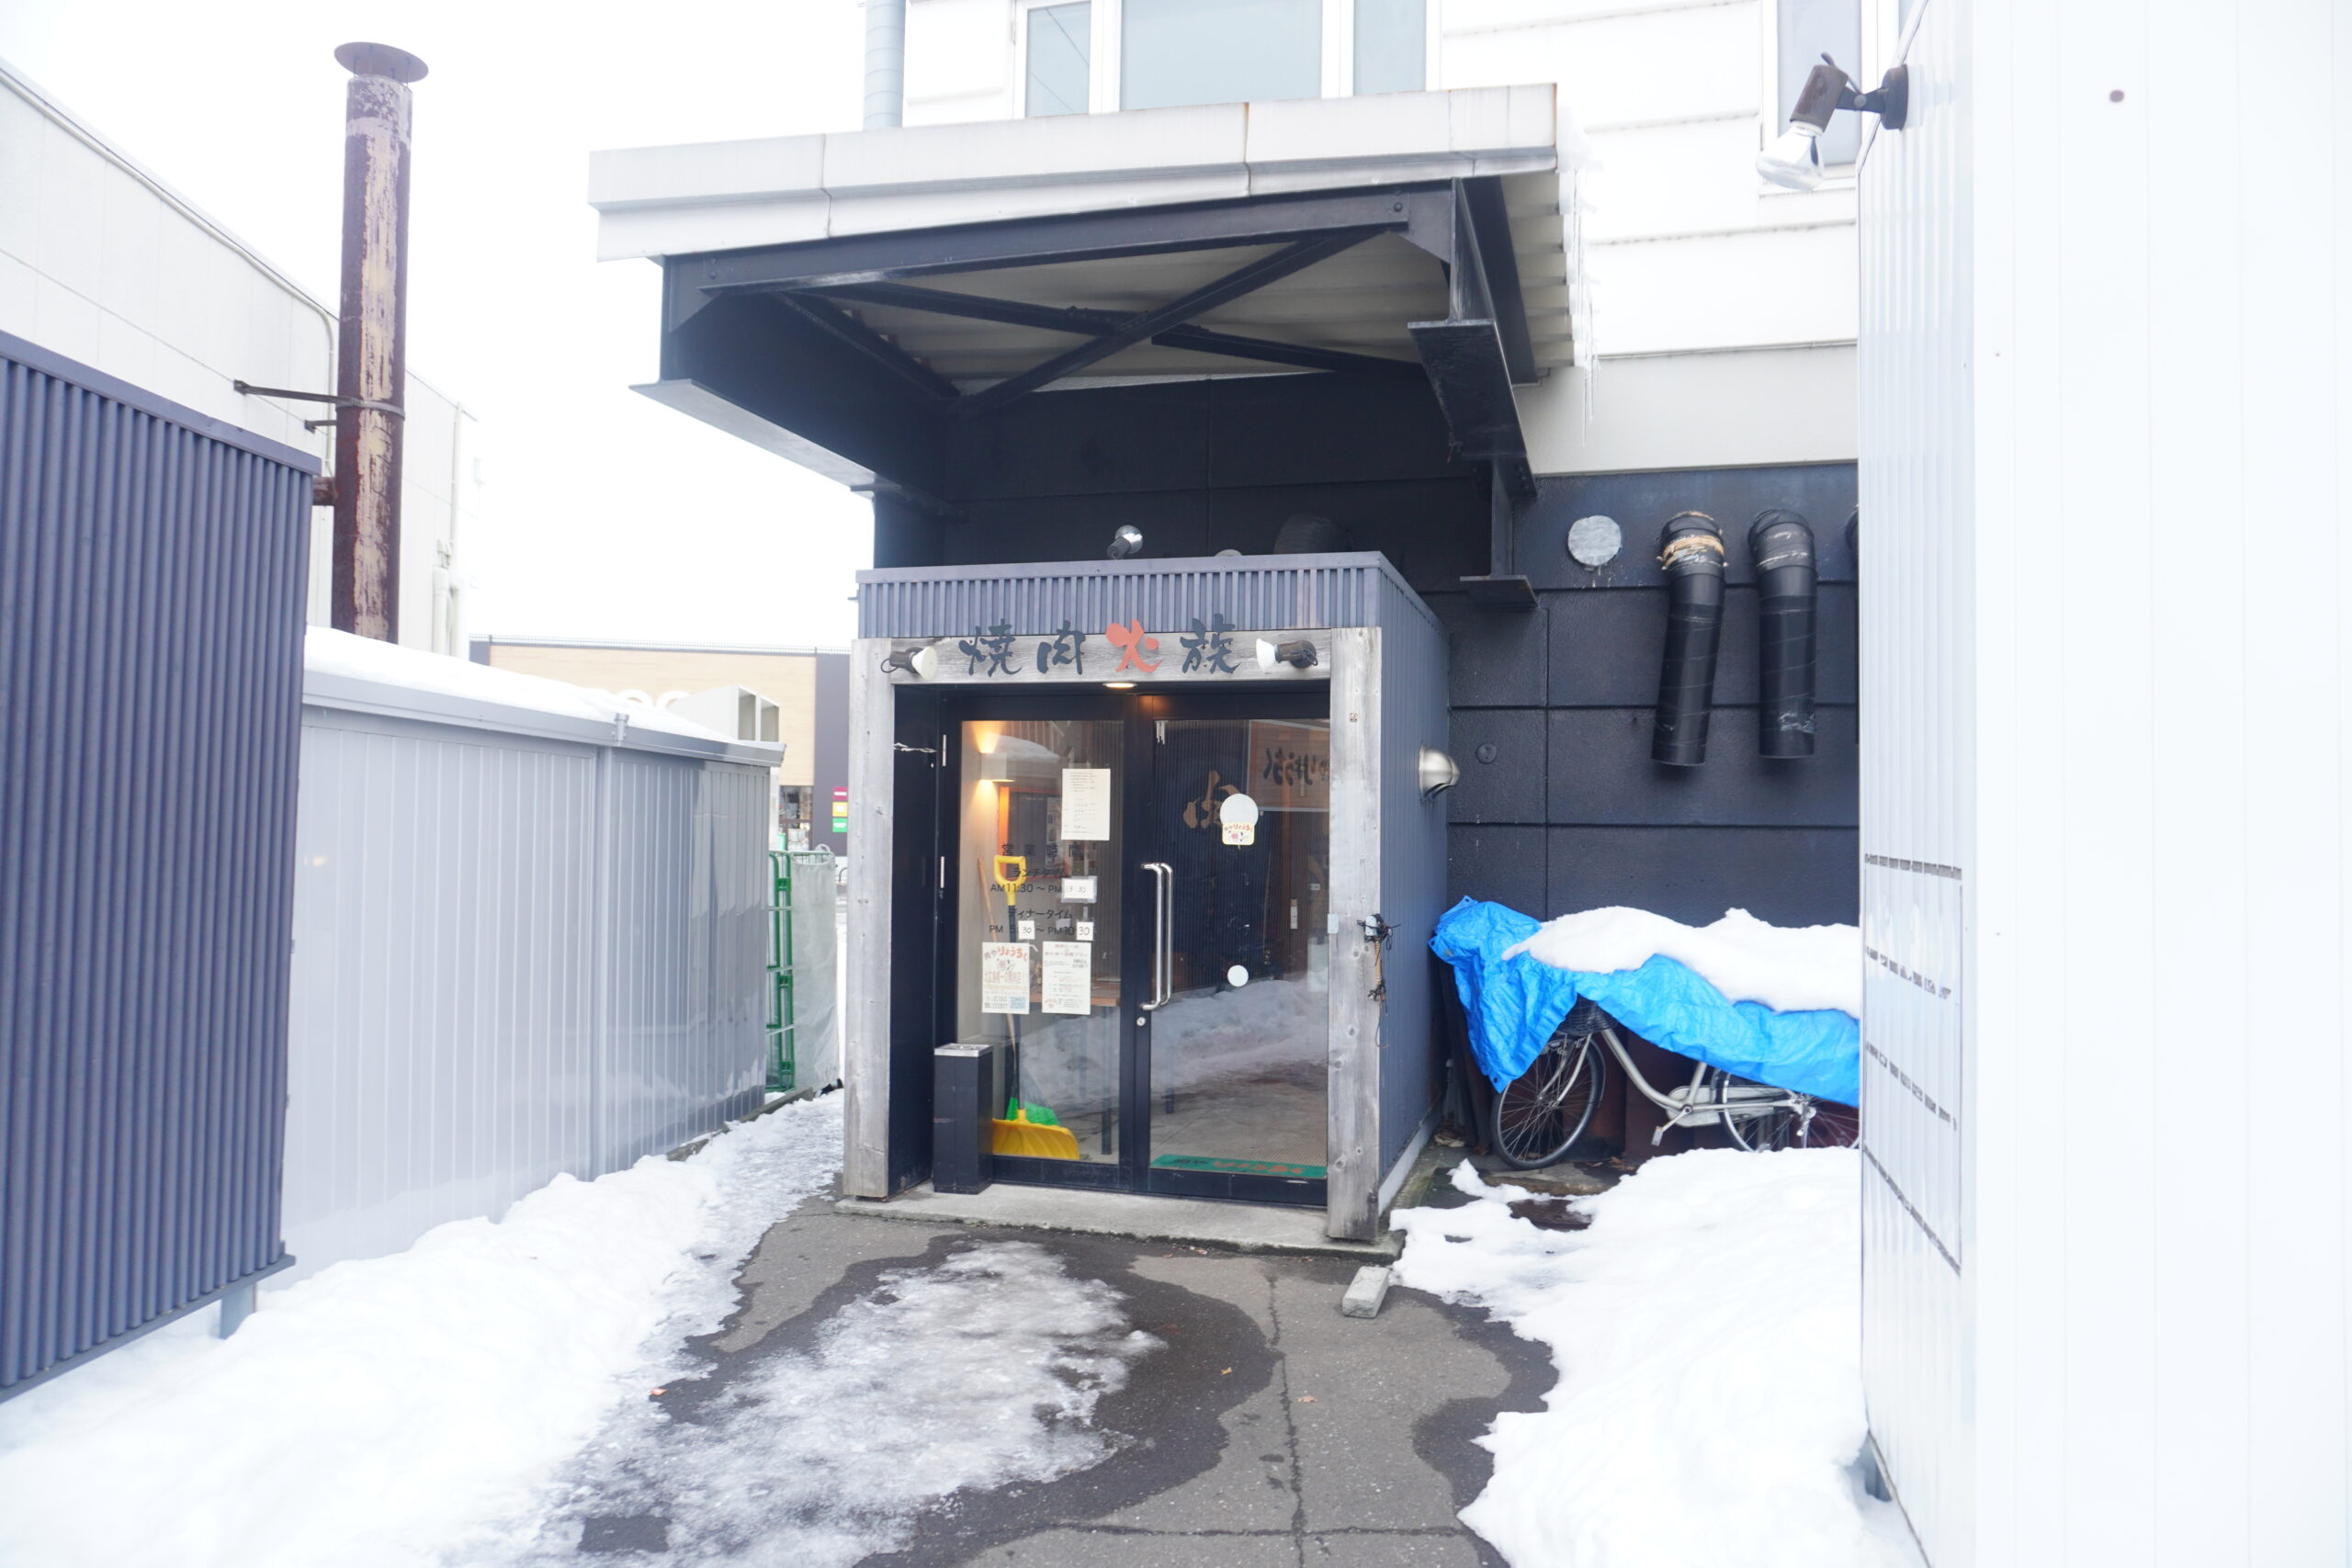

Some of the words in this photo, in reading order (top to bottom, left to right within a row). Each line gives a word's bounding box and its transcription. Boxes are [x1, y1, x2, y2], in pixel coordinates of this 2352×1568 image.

[1008, 908, 1072, 919] ディナータイム
